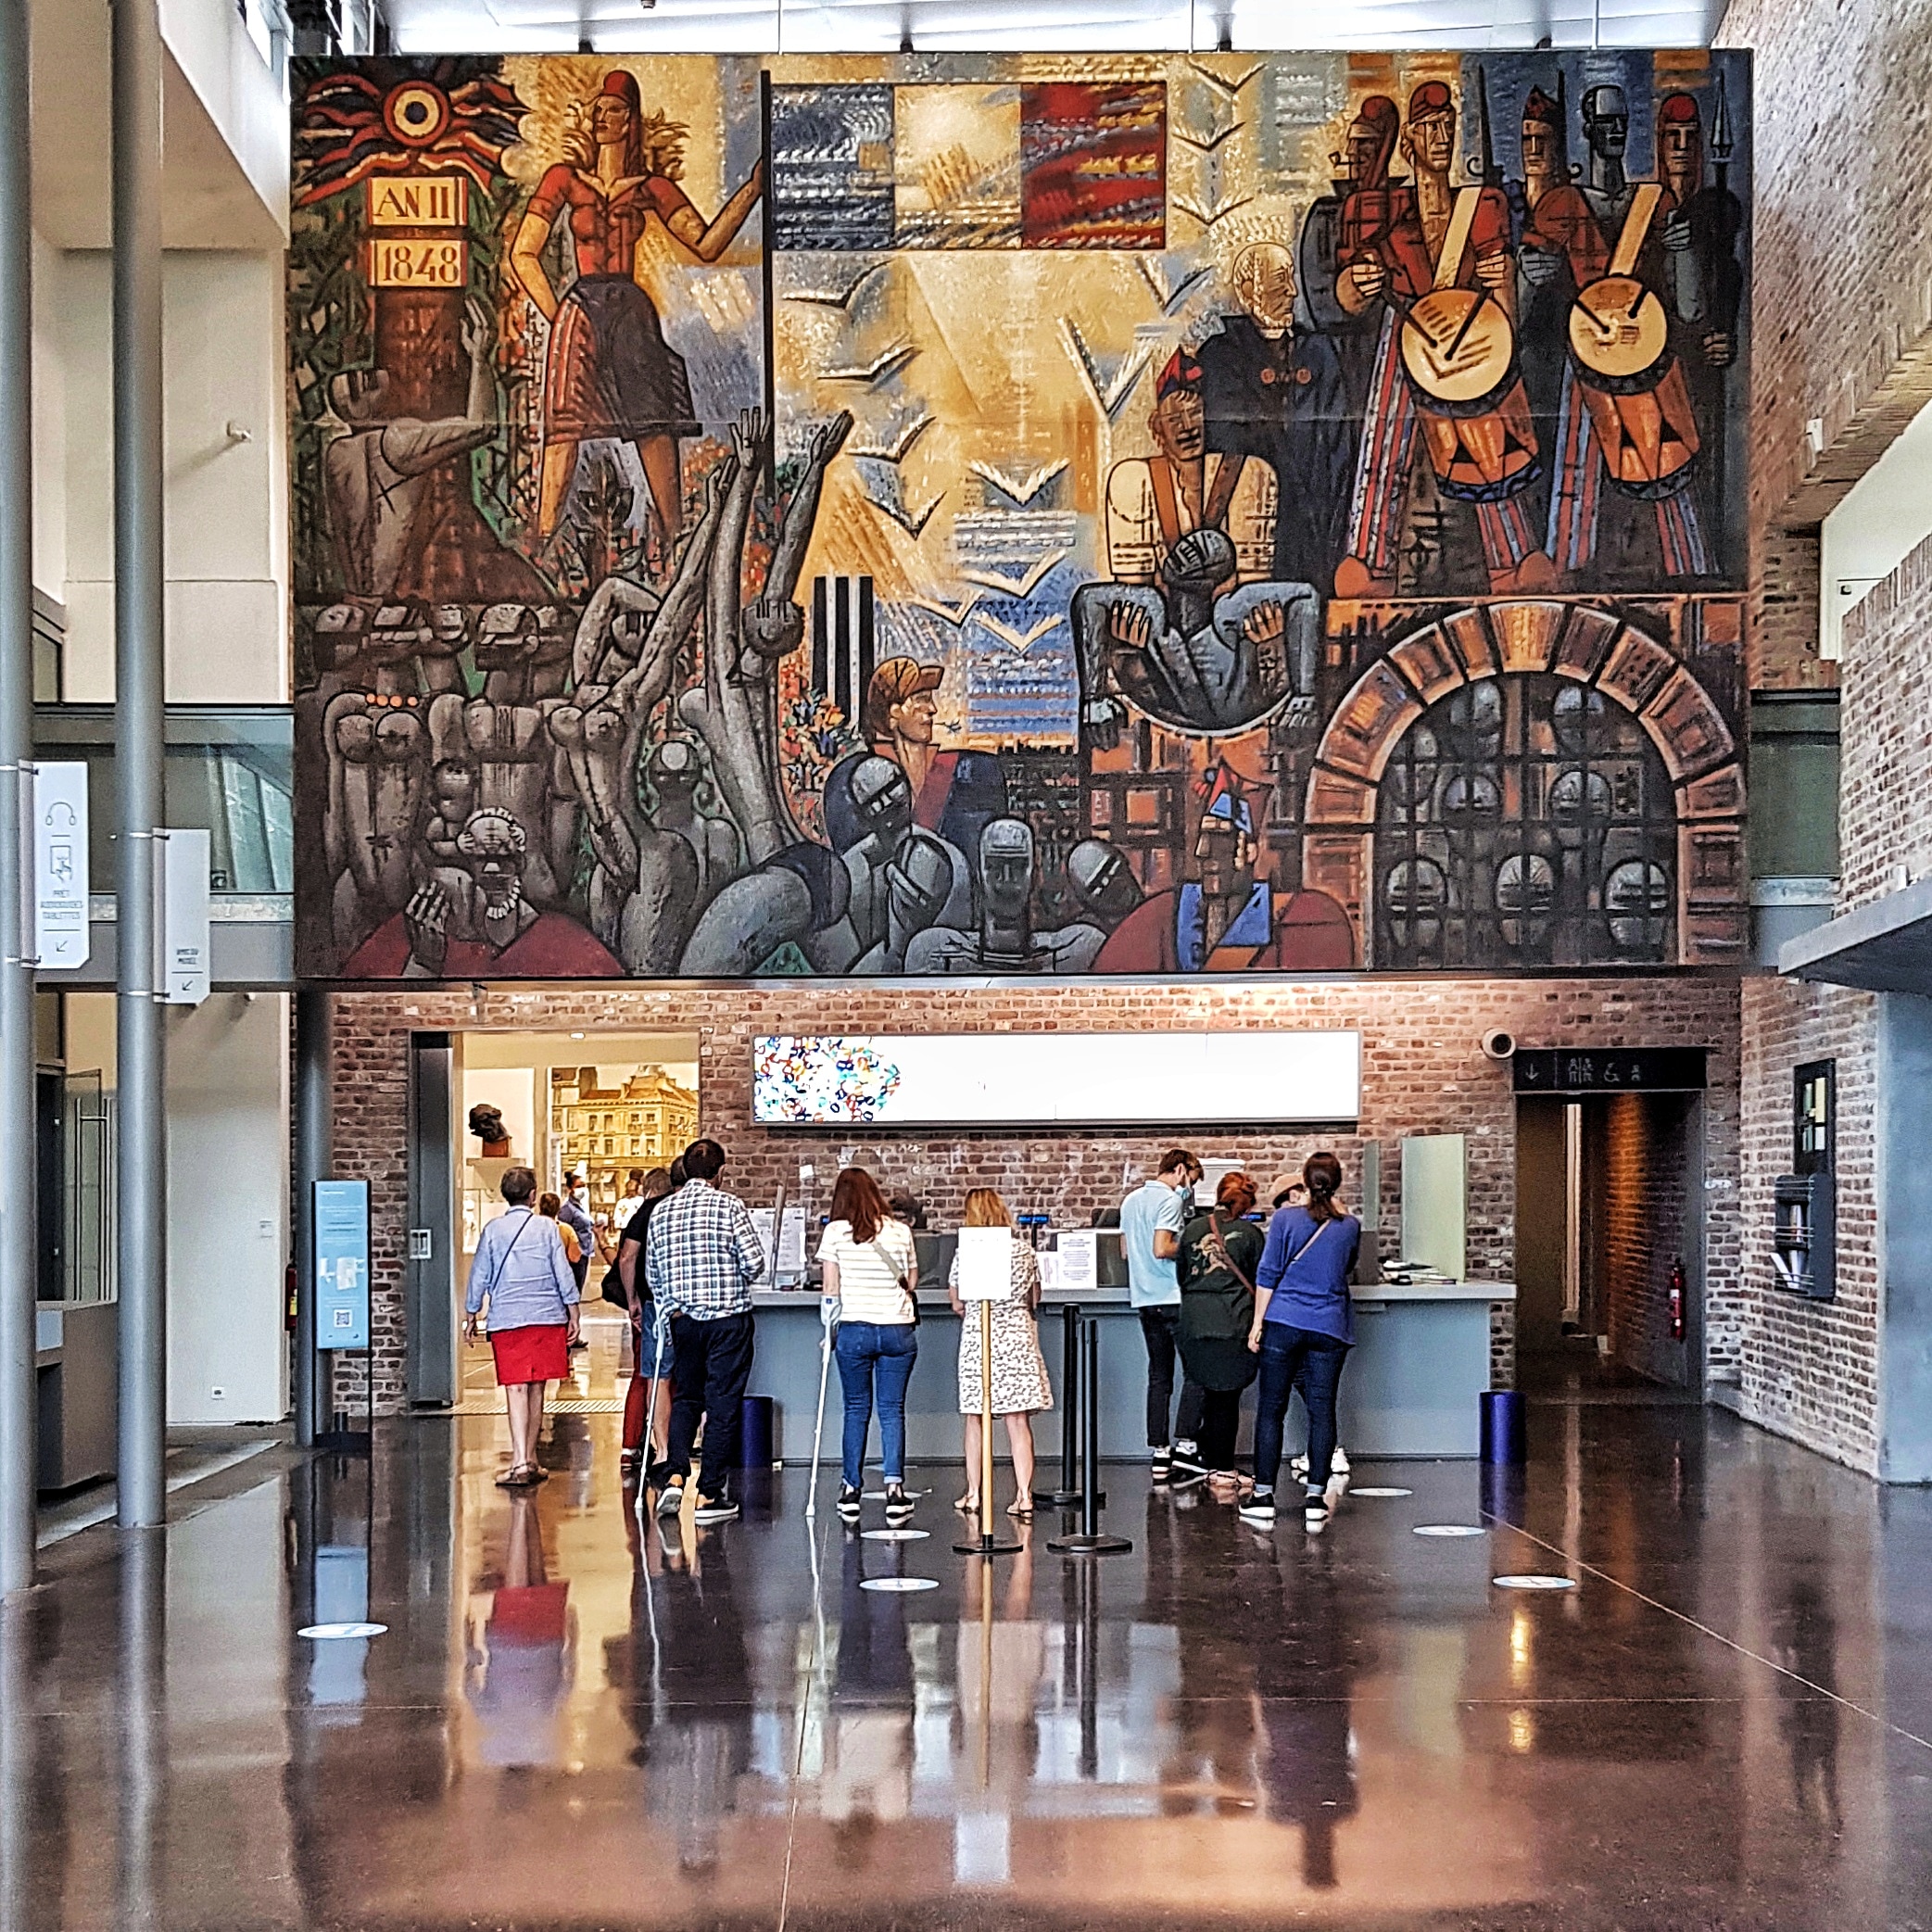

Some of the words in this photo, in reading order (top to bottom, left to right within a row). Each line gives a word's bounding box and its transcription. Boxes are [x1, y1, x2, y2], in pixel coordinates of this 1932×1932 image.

[373, 185, 420, 218] AN
[429, 185, 449, 219] II
[383, 246, 459, 283] 1848
